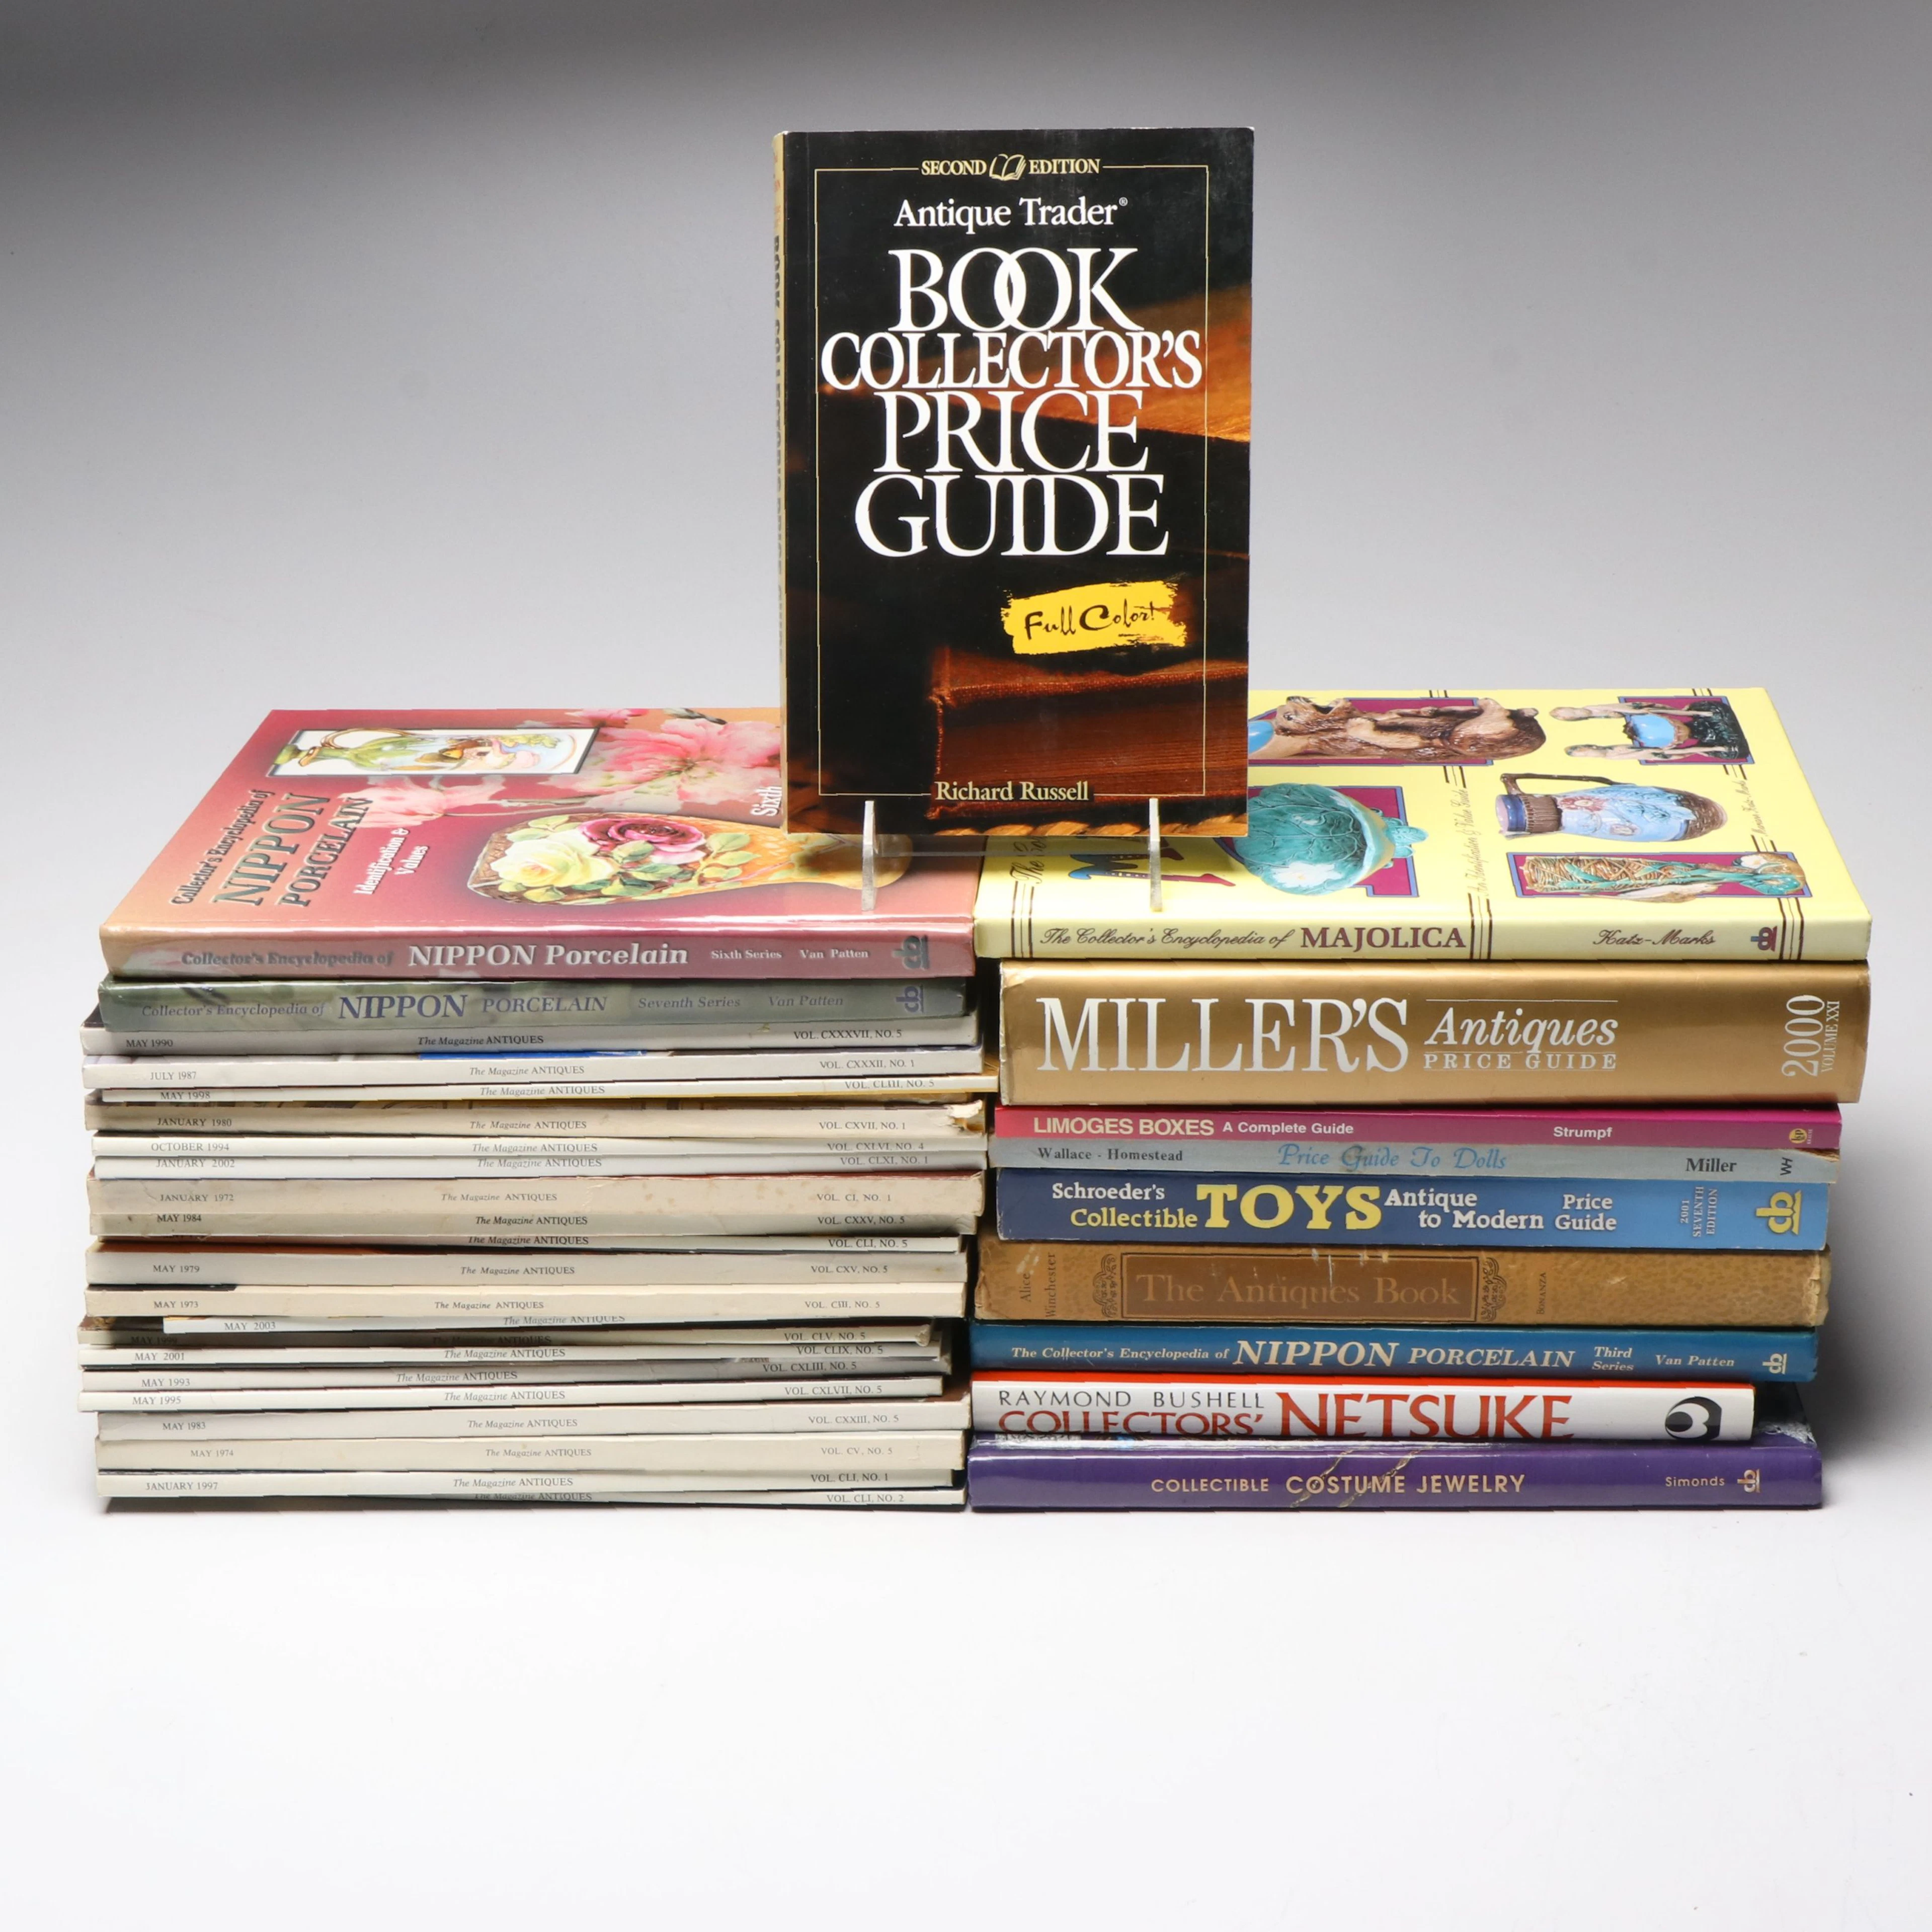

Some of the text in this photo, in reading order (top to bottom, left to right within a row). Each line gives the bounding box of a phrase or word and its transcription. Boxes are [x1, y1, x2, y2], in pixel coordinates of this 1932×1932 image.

[921, 158, 1100, 176] SECOND EDITION
[894, 198, 1011, 234] Antique
[889, 247, 1144, 332] BOOK
[821, 331, 1203, 391] COLLECTOR'S
[873, 390, 1149, 473] PRICE
[855, 474, 1169, 557] GUIDE
[1024, 599, 1155, 640] Full Color!
[750, 786, 782, 817] Sixth
[935, 781, 1089, 801] Richard Russell
[169, 789, 276, 905] Collector's Encyclopedia of
[209, 792, 331, 907] NIPPON
[275, 796, 373, 908] PORCELAIN
[353, 828, 410, 895] Identification &
[394, 845, 429, 875] Values
[1010, 860, 1044, 883] The
[1040, 927, 1466, 952] The Collector's Encyclopedia of MAJOLICA
[1592, 929, 1716, 947] Katz-Marks
[181, 943, 688, 967] Collector's Encyclopedia of NIPPON Porcelain
[711, 949, 782, 959] Sixth Series
[800, 949, 868, 958] Van Patten
[142, 994, 608, 1019] Collector's Encyclopedia of NIPPON PORCELAIN
[638, 997, 741, 1008] Seventh Series
[769, 995, 843, 1007] Van Patten
[418, 1035, 543, 1046] The Magazine ANTIQUES
[794, 1031, 819, 1039] VOL.
[875, 1030, 894, 1038] NO.
[897, 1029, 902, 1037] 5
[1036, 997, 1408, 1073] MILLER'S
[1424, 1008, 1618, 1054] Antiques
[1782, 995, 1826, 1077] 2000
[1821, 1001, 1840, 1072] VOLUME XXI
[470, 1066, 584, 1076] The Magazine ANTIQUES
[820, 1061, 843, 1069] VOL.
[1423, 1052, 1617, 1070] PRICE GUIDE
[1033, 1117, 1354, 1137] LIMOGES BOXES A Complete Guide
[1553, 1126, 1613, 1141] Strumpf
[1038, 1147, 1092, 1161] Wallace
[1107, 1148, 1183, 1162] Homestead
[1278, 1143, 1507, 1171] Price Guide To Dolls
[1685, 1157, 1737, 1174] Miller
[1052, 1182, 1166, 1201] Schroeder's
[1385, 1188, 1478, 1214] Antique
[1562, 1194, 1613, 1211] Price
[157, 1214, 201, 1223] MAY 1984
[1070, 1207, 1198, 1229] Collectible
[1196, 1184, 1383, 1231] TOYS
[1680, 1200, 1689, 1224] 2001
[1693, 1187, 1704, 1237] SEVENTH
[1706, 1189, 1718, 1234] EDITION
[475, 1217, 588, 1225] The Magazine ANTIQUES
[818, 1217, 842, 1225] VOL.
[1418, 1210, 1545, 1230] to Modern
[1555, 1215, 1617, 1232] Guide
[480, 1267, 519, 1275] Magazine
[523, 1267, 575, 1275] ANTIQUES
[1019, 1273, 1031, 1303] Alice
[1044, 1252, 1056, 1317] Winchester
[1136, 1271, 1460, 1309] The Antiques Book
[1536, 1272, 1547, 1314] BONANZA
[1011, 1340, 1576, 1368] The Collector's Encyclopedia of NIPPON PORCELAIN
[1594, 1346, 1633, 1359] Third
[1655, 1355, 1735, 1368] Van Patten
[1591, 1361, 1634, 1372] Series
[132, 1396, 181, 1405] MAY 1995
[444, 1391, 565, 1402] The Magazine ANTIQUES
[784, 1387, 809, 1395] VOL.
[855, 1386, 874, 1394] NO.
[876, 1386, 882, 1394] 5
[999, 1391, 1265, 1408] RAYMOND BUSHELL
[999, 1411, 1262, 1436] COLLECTORS'
[1275, 1392, 1574, 1439] NETSUKE
[1151, 1474, 1525, 1494] COLLECTIBLE COSTUME JEWELRY
[1664, 1476, 1725, 1487] Simonds
